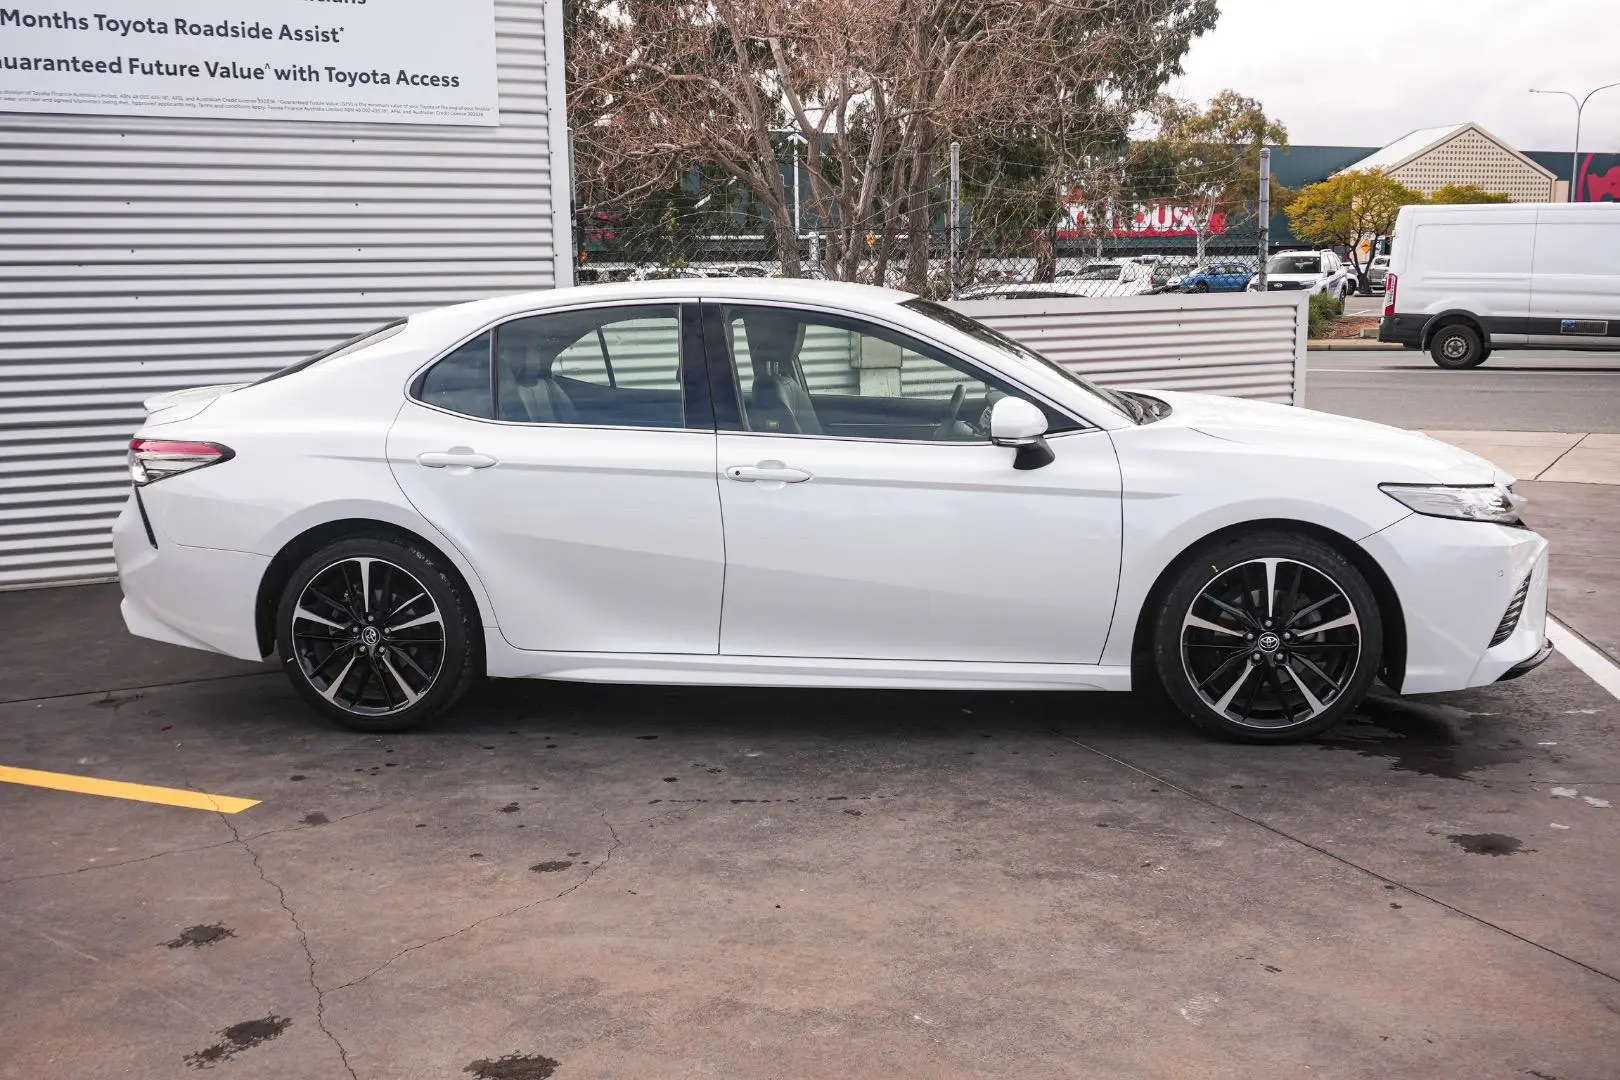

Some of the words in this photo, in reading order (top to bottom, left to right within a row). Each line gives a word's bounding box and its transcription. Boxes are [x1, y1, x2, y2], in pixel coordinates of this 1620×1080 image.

[0, 9, 89, 31] Months
[93, 13, 169, 37] Toyota
[174, 17, 273, 40] Roadside
[0, 55, 123, 75] uaranteed
[128, 57, 200, 78] Future
[273, 64, 320, 82] with
[324, 66, 391, 87] Toyota
[395, 69, 460, 88] Access
